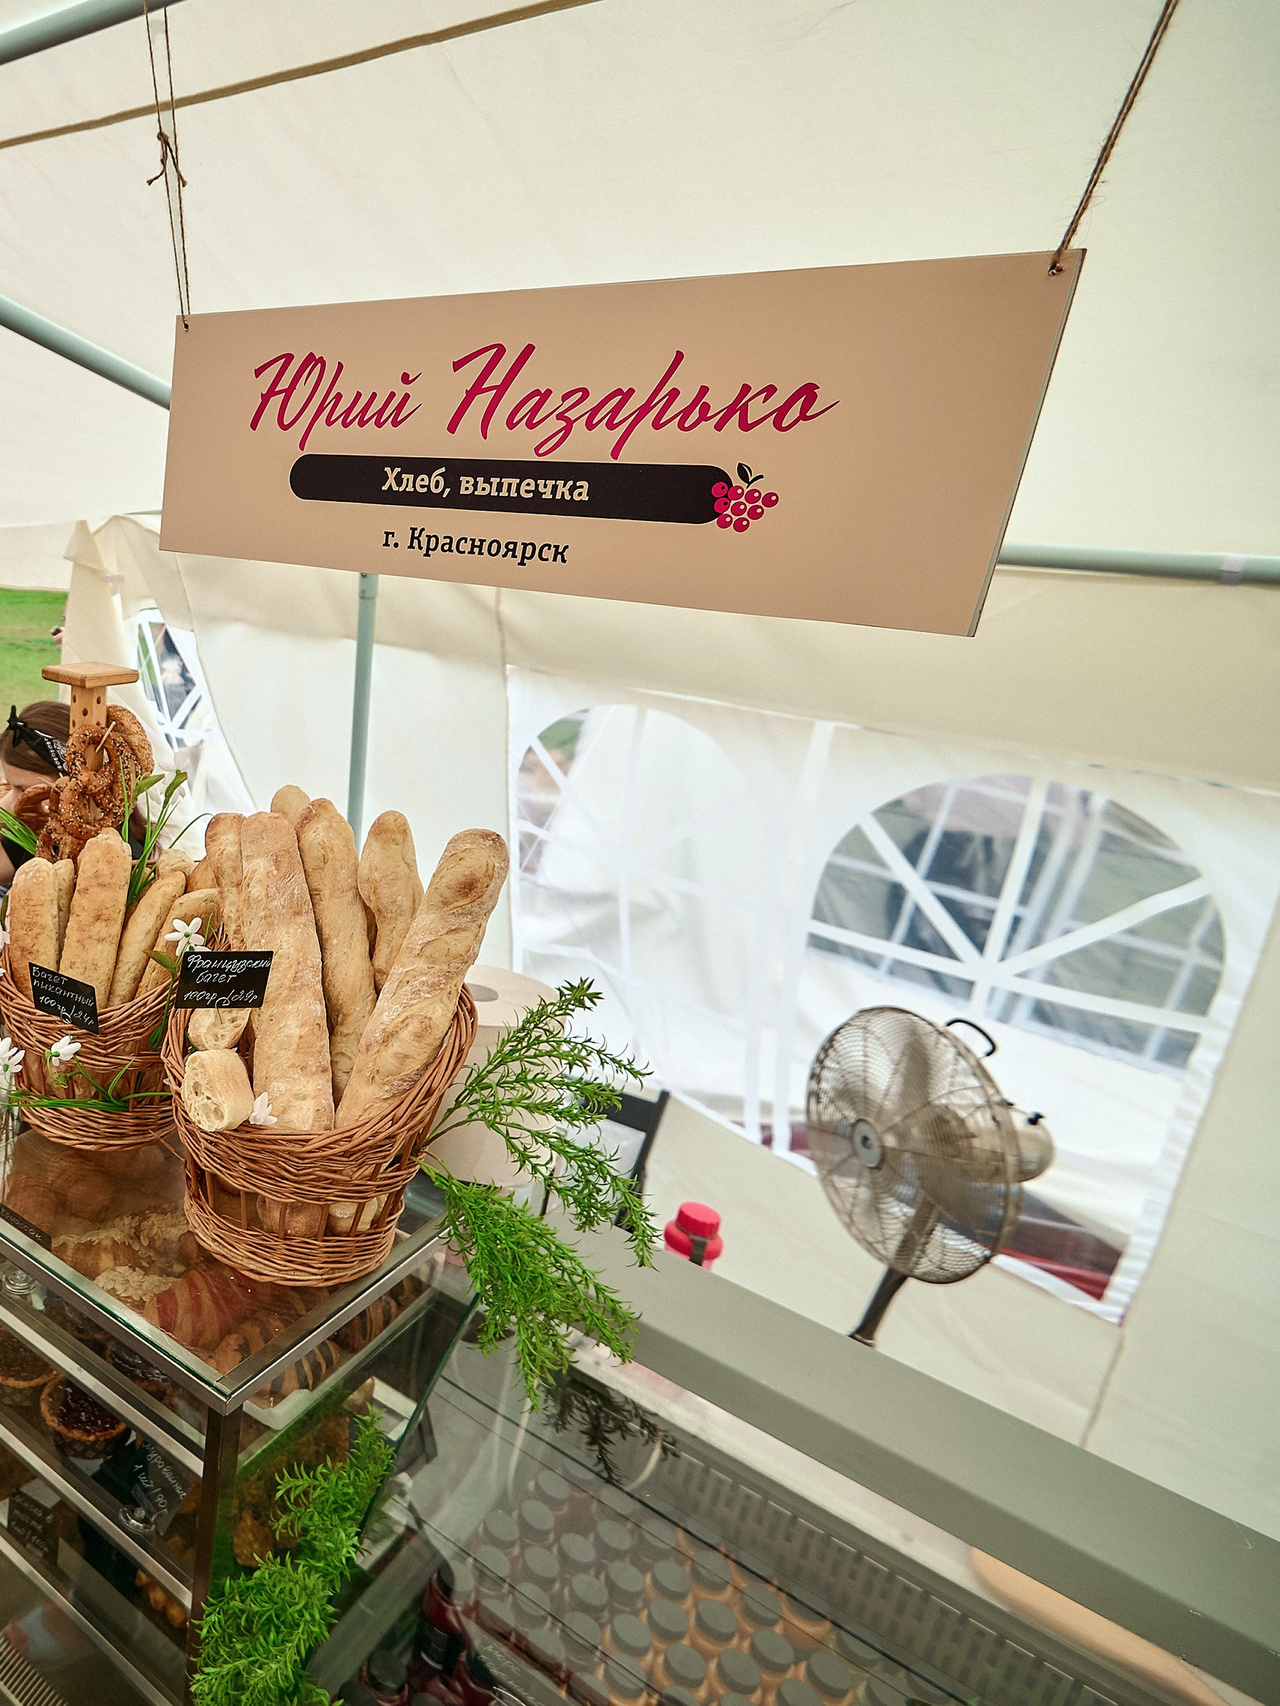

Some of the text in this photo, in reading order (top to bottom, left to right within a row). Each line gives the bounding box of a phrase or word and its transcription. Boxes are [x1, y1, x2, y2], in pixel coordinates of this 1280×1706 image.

[250, 342, 840, 461] Юрий Назарько
[381, 466, 589, 502] Хлеб, выпечка
[382, 527, 570, 567] г. Красноярск
[32, 966, 68, 985] Багет
